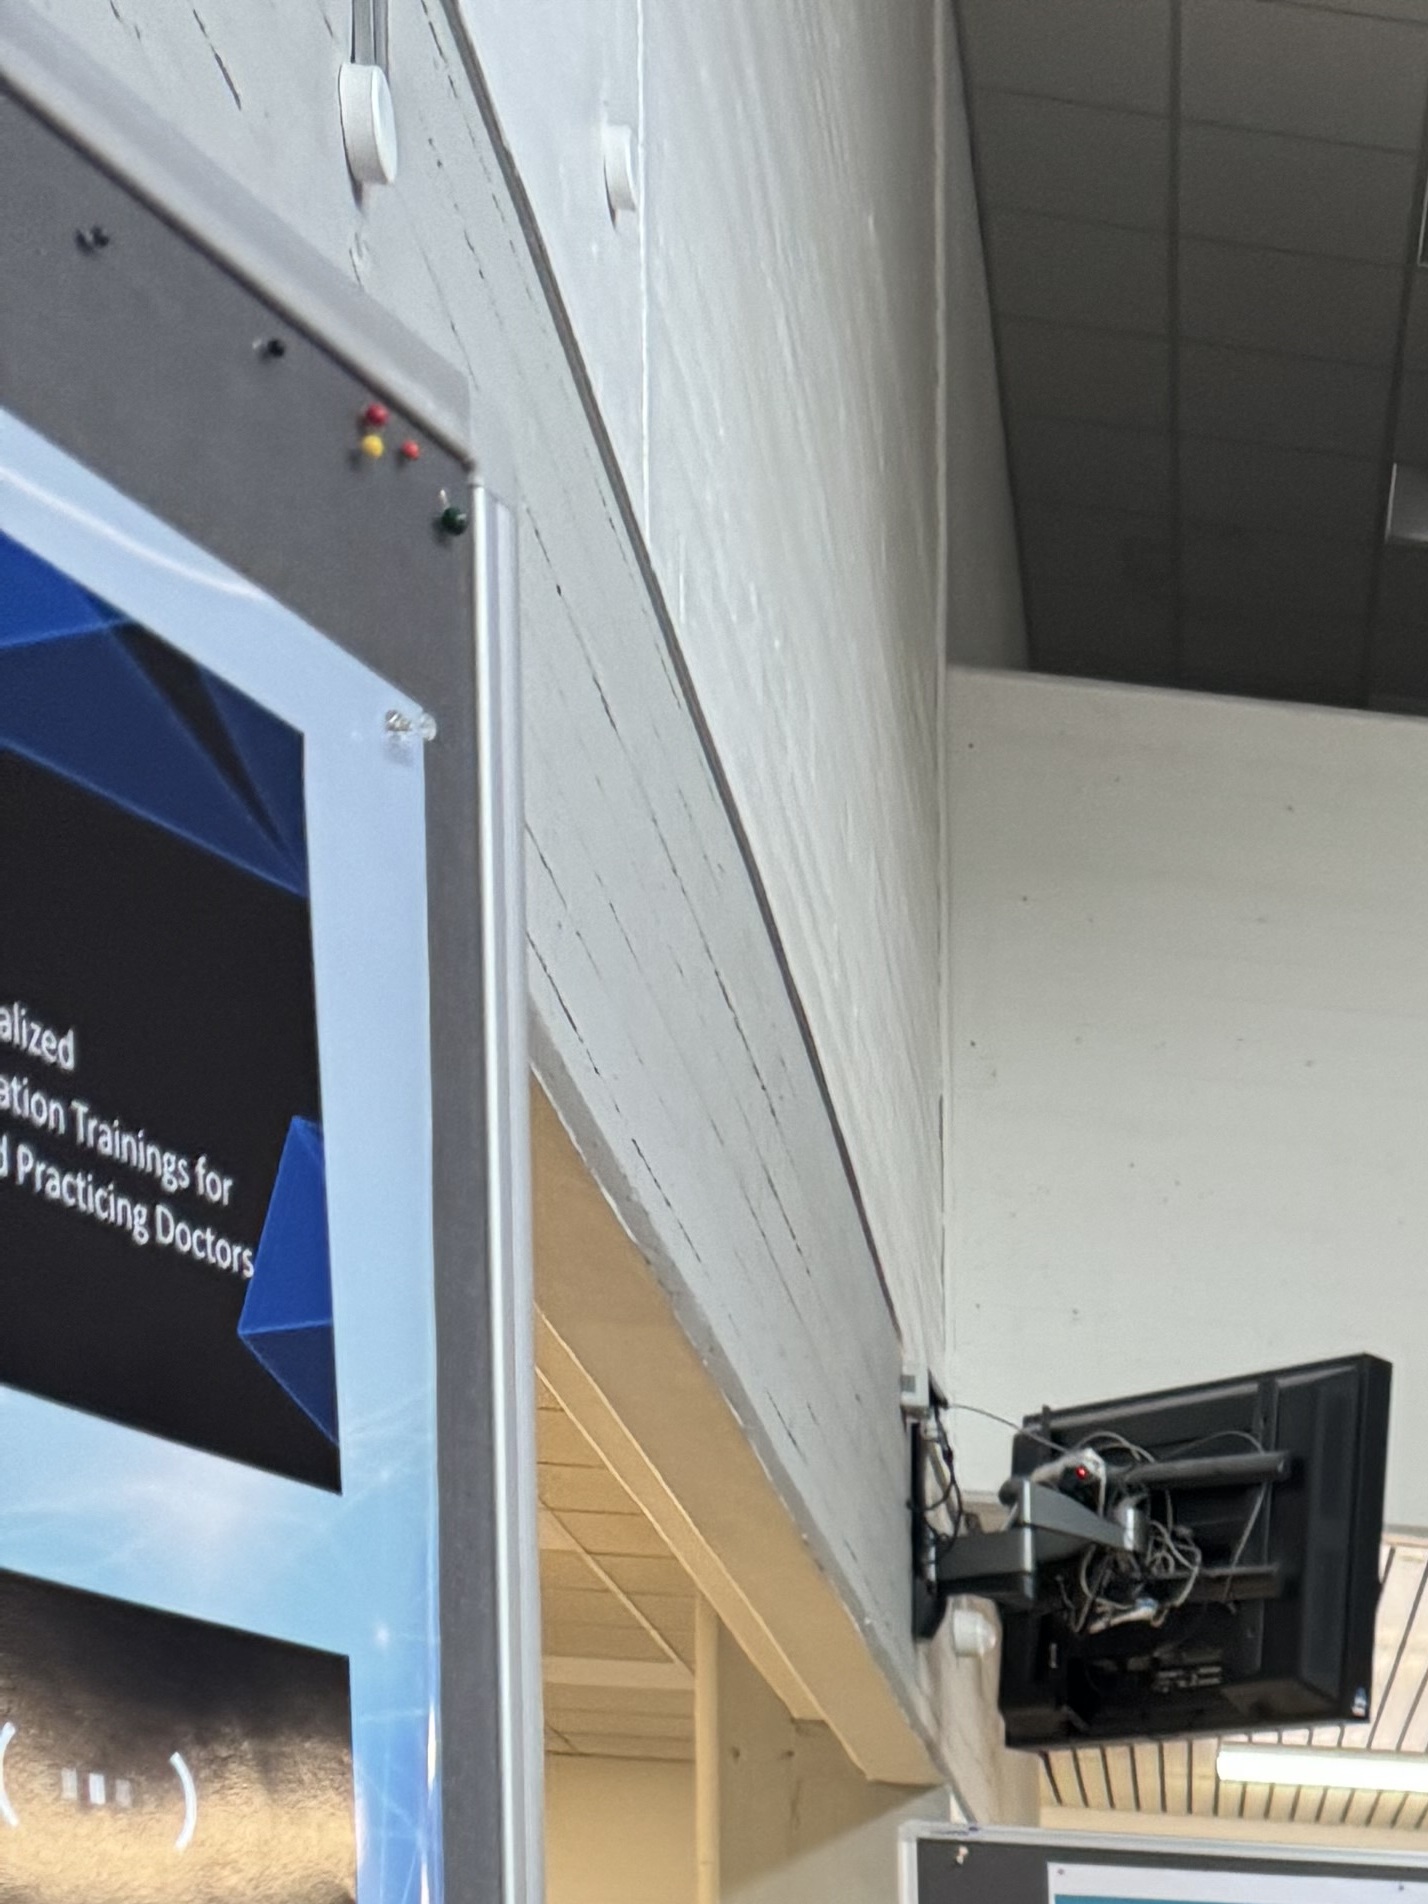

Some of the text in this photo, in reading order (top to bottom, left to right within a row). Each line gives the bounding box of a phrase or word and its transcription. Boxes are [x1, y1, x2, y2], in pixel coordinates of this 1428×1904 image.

[16, 1142, 149, 1246] Practicing
[155, 1203, 254, 1279] Doctors
[71, 1099, 190, 1193] Trainings
[195, 1153, 233, 1206] for
